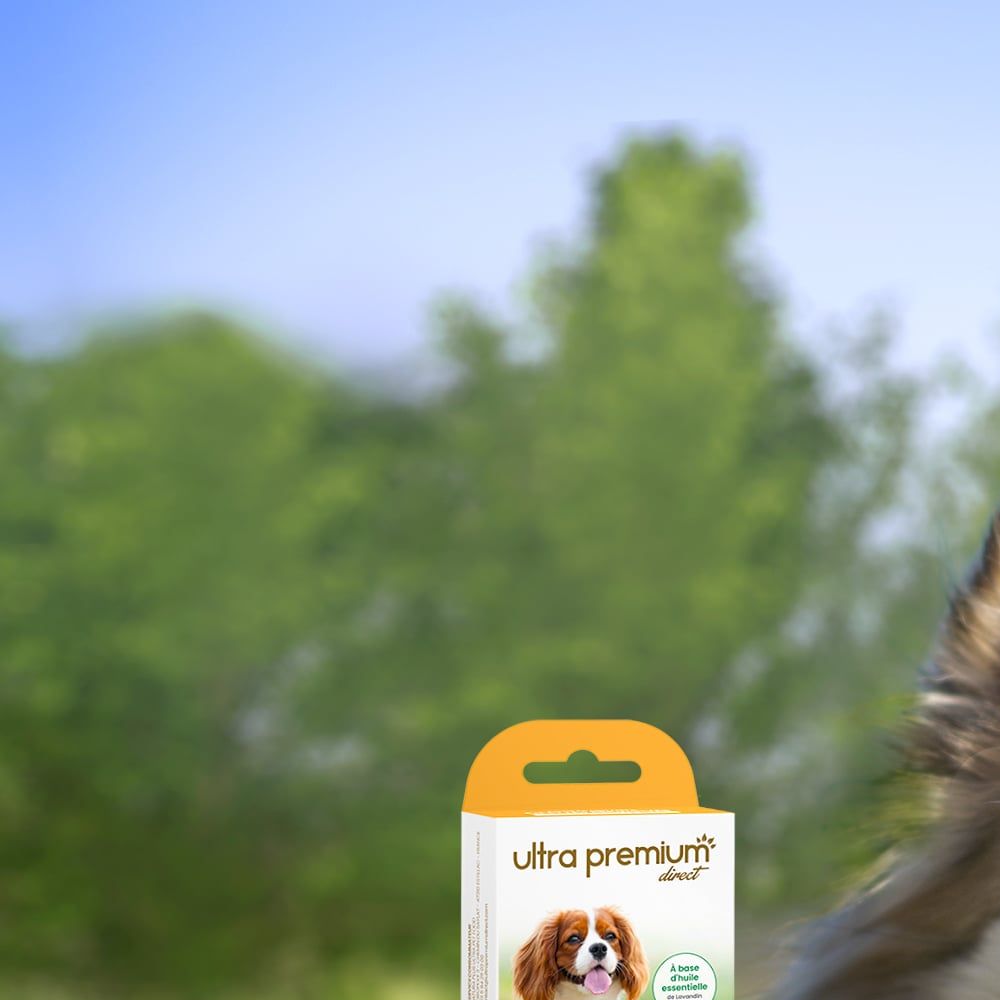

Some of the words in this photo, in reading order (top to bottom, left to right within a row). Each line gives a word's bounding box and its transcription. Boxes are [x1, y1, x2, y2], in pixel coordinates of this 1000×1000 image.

[513, 841, 577, 870] ultra
[586, 840, 710, 878] premium
[658, 866, 709, 882] direct
[678, 964, 700, 972] base
[670, 973, 699, 982] d'huile
[661, 983, 708, 992] essentielle
